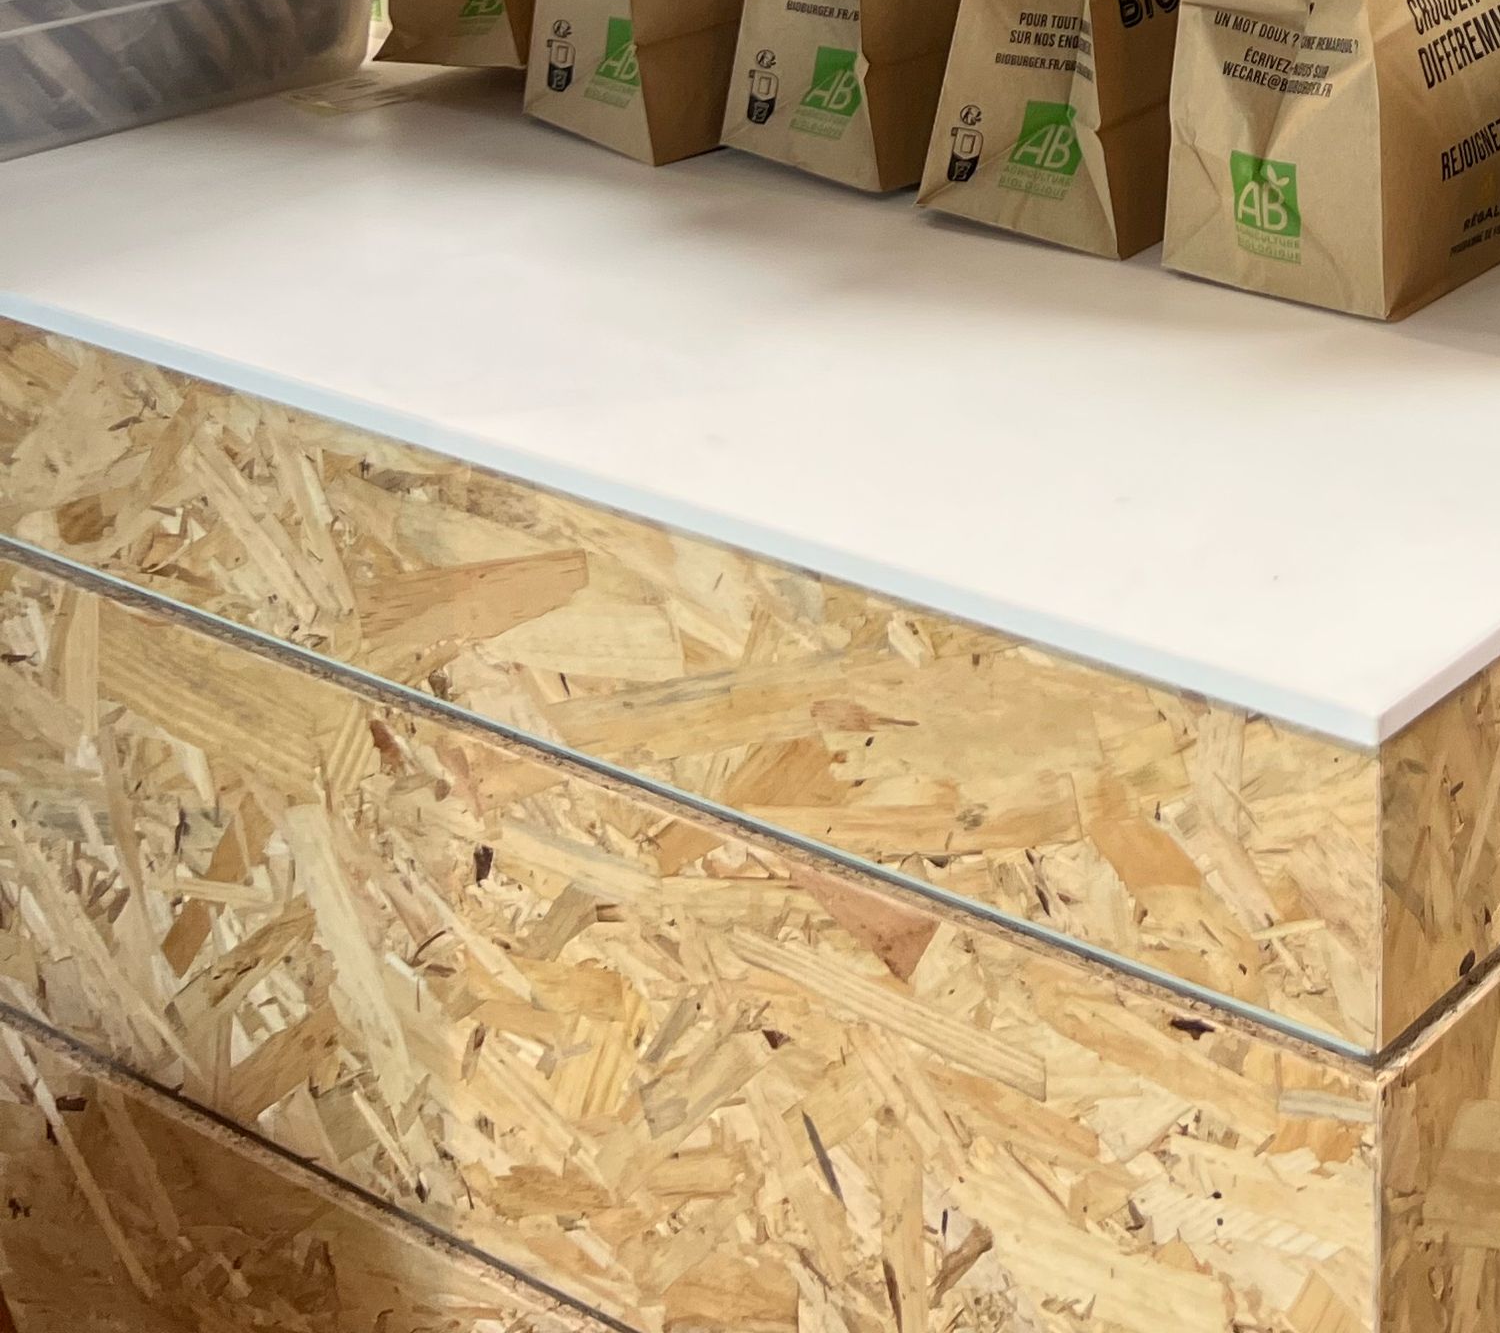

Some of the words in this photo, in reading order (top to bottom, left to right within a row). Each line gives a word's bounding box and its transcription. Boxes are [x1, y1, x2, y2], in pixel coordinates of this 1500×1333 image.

[1010, 30, 1032, 45] SUR
[1034, 33, 1056, 47] NOS
[1018, 11, 1048, 28] POUR
[1051, 16, 1078, 31] TOUT
[1214, 10, 1230, 28] UN
[1232, 15, 1257, 35] MOT
[1259, 23, 1289, 45] DOUX
[1014, 123, 1075, 169] AB
[1237, 180, 1288, 231] AB
